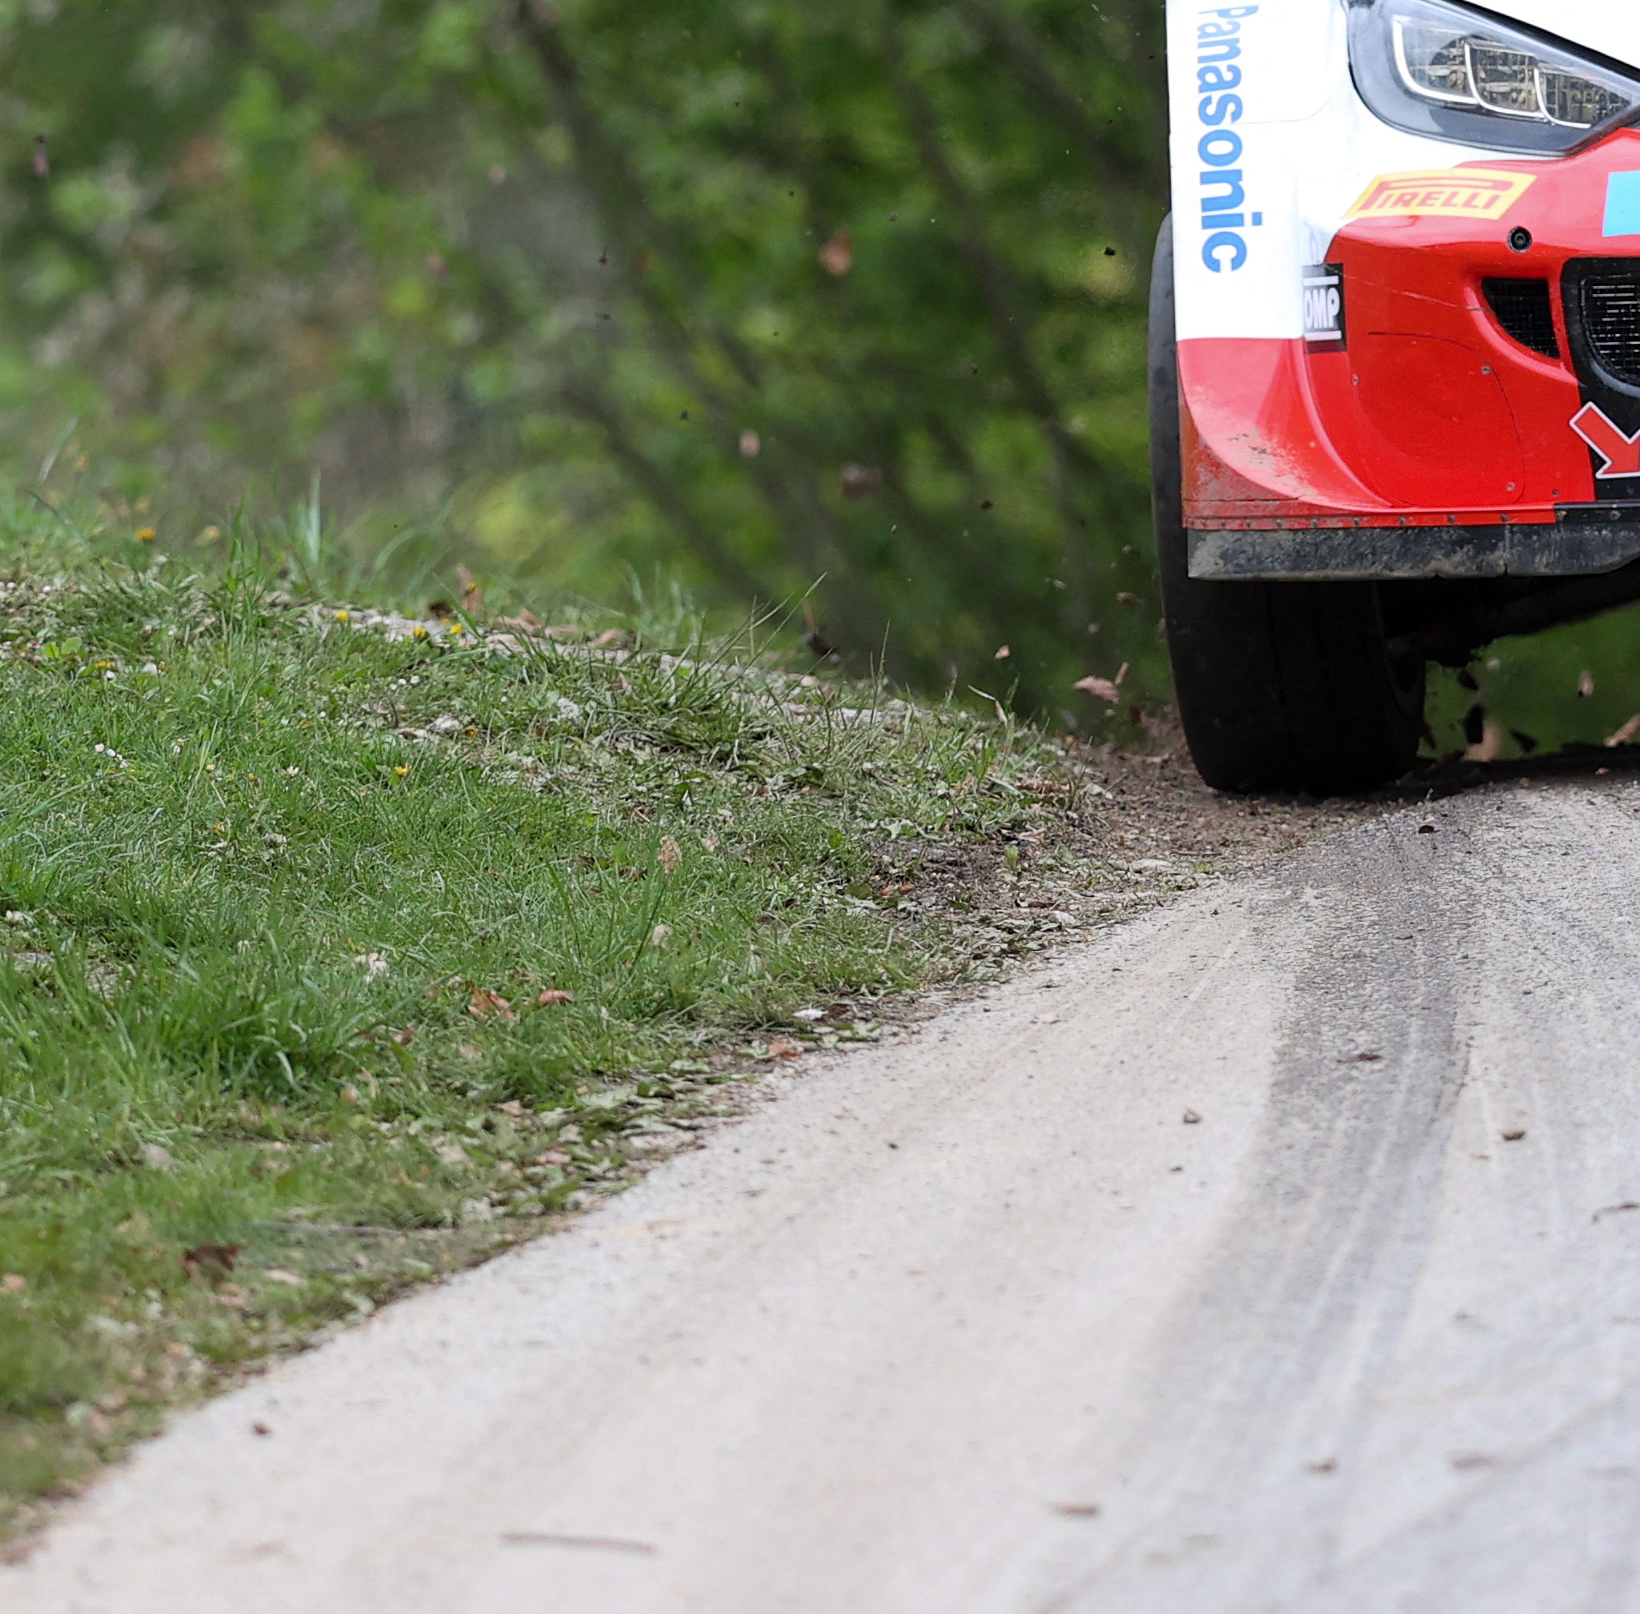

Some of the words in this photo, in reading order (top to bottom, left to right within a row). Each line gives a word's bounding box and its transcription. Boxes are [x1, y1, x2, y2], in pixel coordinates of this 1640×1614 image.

[1196, 4, 1263, 273] Panasonic
[1357, 176, 1515, 212] PIRELLI
[1304, 287, 1340, 329] OMP
